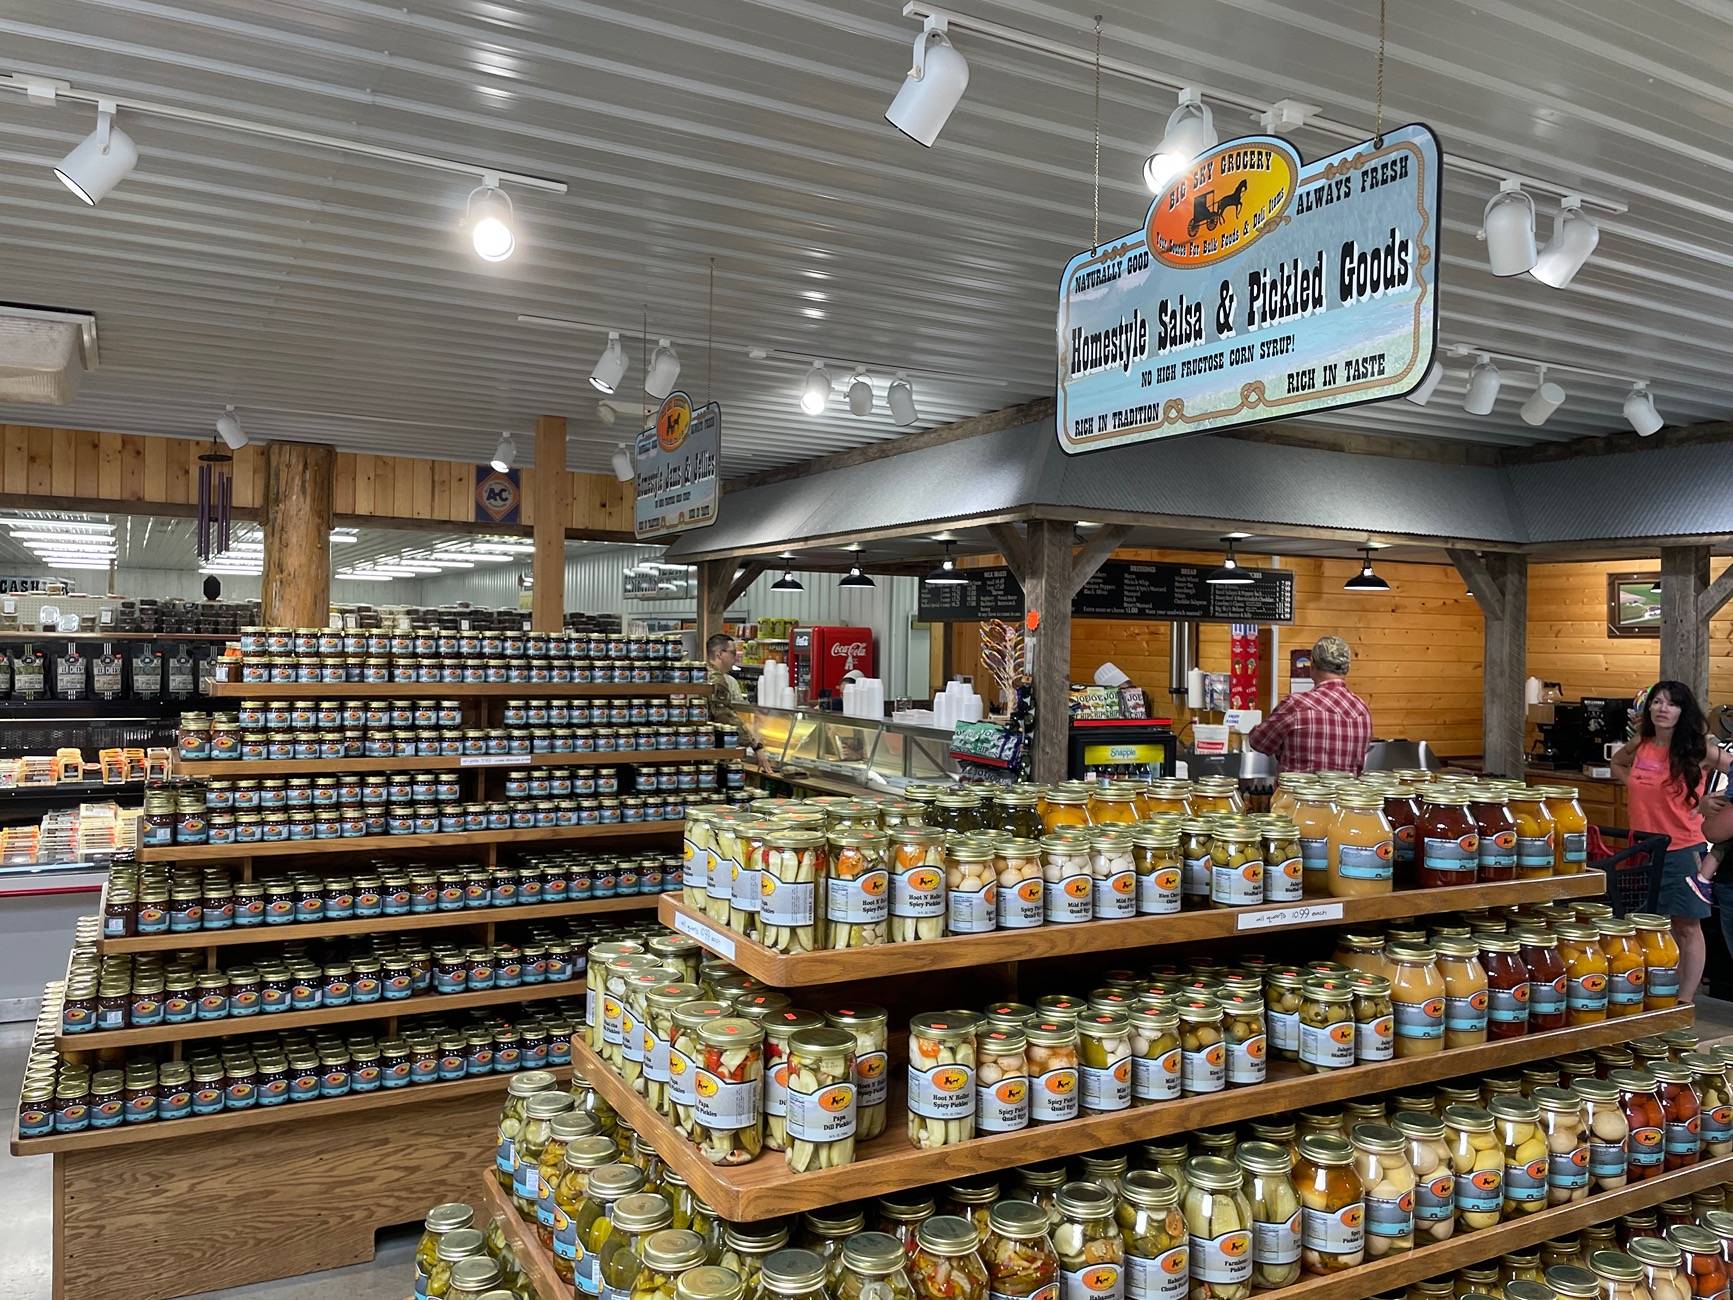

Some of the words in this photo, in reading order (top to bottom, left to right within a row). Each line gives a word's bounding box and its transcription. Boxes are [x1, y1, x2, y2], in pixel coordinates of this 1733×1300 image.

[1169, 182, 1187, 211] BIG
[1194, 161, 1214, 190] SKY
[1221, 150, 1272, 176] GROCERY
[1296, 178, 1351, 216] ALWAYS
[1360, 155, 1410, 193] FRESH
[1189, 240, 1200, 256] For
[1203, 239, 1218, 254] Bulk
[1220, 229, 1240, 249] Foods
[1243, 221, 1249, 236] &
[1253, 206, 1265, 230] Deli
[1074, 260, 1123, 294] NATURALLY
[1126, 251, 1150, 281] GOOD
[1072, 308, 1147, 377] Homestyle
[1158, 294, 1203, 351] Salsa
[1215, 279, 1237, 337] &
[1248, 250, 1324, 328] Pickled
[1340, 228, 1410, 299] Goods
[1140, 370, 1152, 388] NO
[1156, 365, 1176, 386] HIGH
[1180, 356, 1224, 380] FRUCTOSE
[1229, 348, 1255, 368] CORN
[1260, 336, 1296, 363] SYRUP!
[1286, 368, 1316, 394] RICH
[1322, 364, 1338, 386] IN
[1344, 353, 1386, 381] TASTE
[1074, 416, 1094, 437] RICH
[1098, 412, 1108, 432] IN
[1112, 402, 1160, 430] TRADITION
[0, 580, 69, 596] CASHR
[831, 642, 866, 656] Coca-Cola
[1110, 746, 1136, 758] Snapple
[699, 1099, 709, 1108] Papa
[700, 1108, 717, 1117] Pickles
